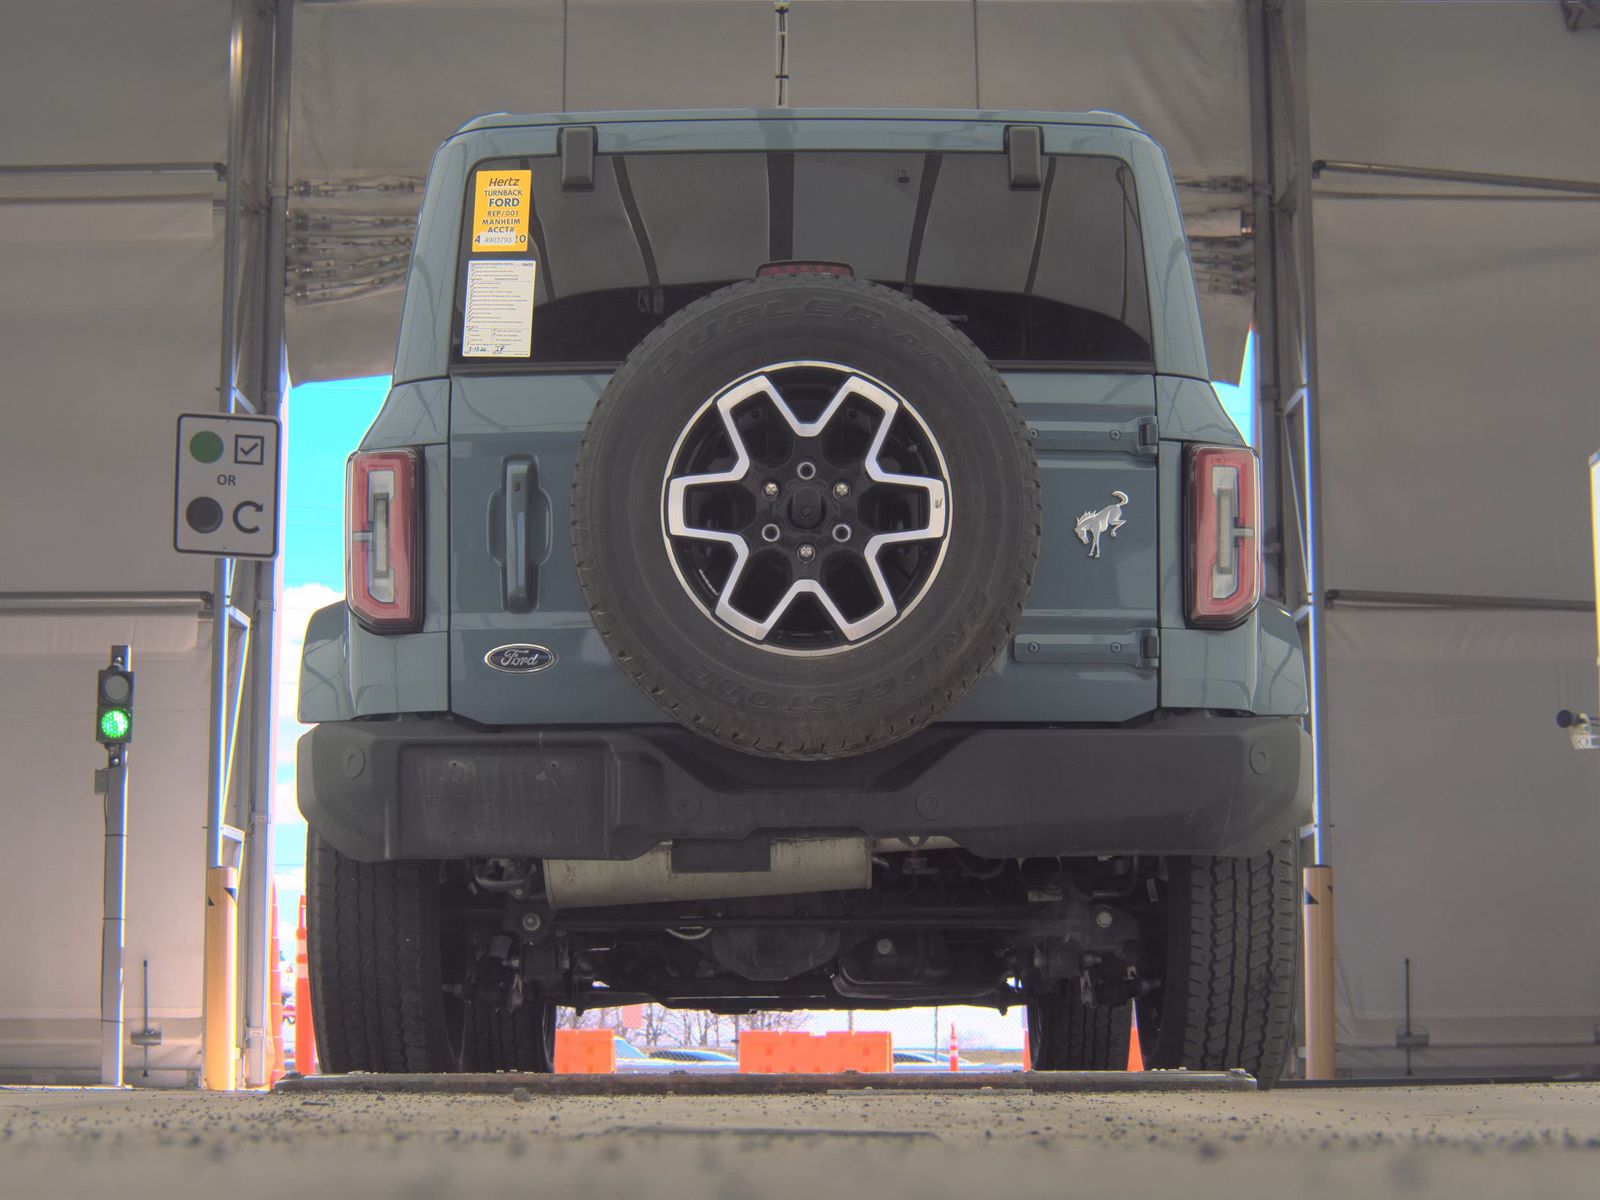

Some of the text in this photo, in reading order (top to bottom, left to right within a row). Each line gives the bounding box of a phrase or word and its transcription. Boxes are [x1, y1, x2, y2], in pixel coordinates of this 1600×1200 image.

[488, 177, 520, 187] Hertz
[489, 198, 520, 207] FORD
[648, 296, 888, 386] DUELER
[217, 474, 236, 486] OR
[685, 580, 993, 714] BRIDGESTONE
[500, 649, 539, 666] Ford
